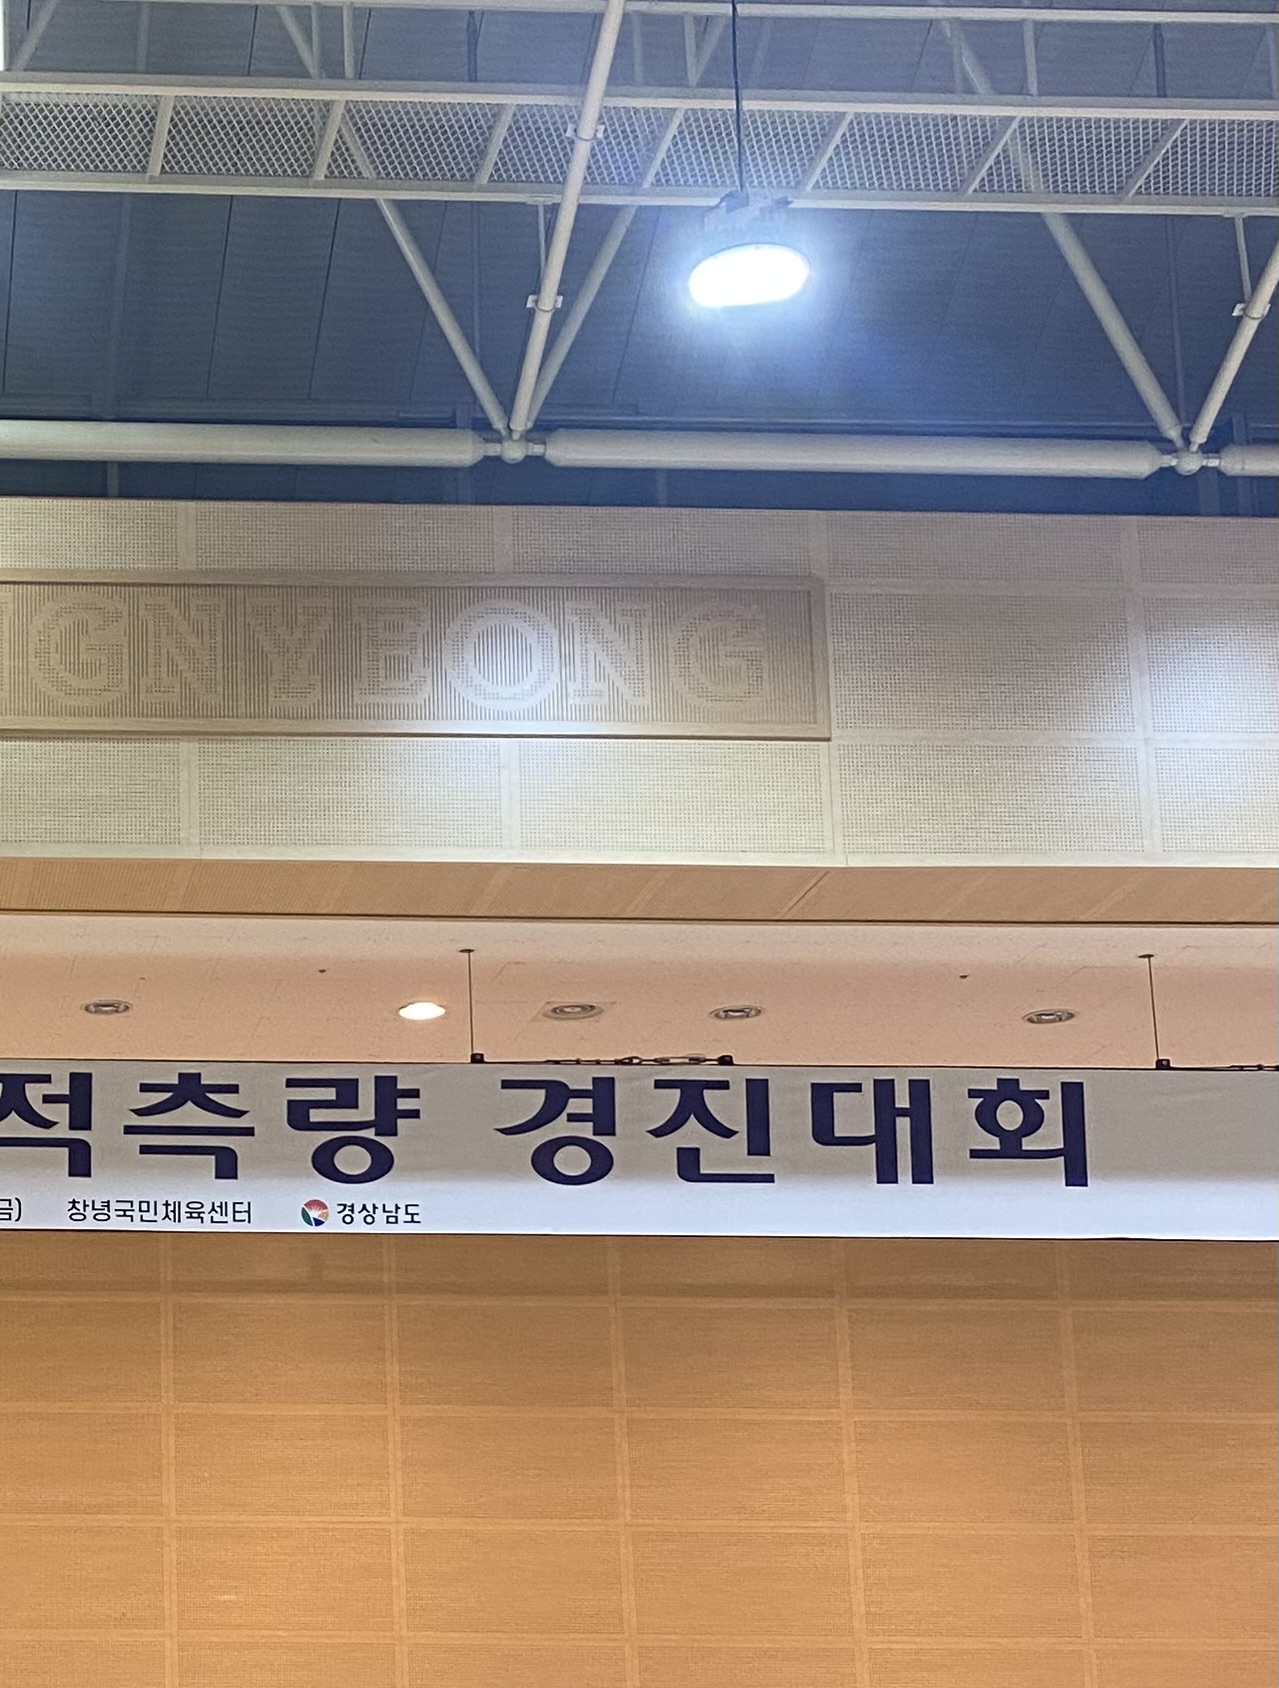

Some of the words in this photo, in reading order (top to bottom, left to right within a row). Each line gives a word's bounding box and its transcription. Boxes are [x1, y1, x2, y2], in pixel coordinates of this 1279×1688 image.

[493, 1076, 1089, 1188] 경진대회
[67, 1198, 252, 1224] 창녕국민체육센터
[336, 1202, 422, 1225] 경상남도
